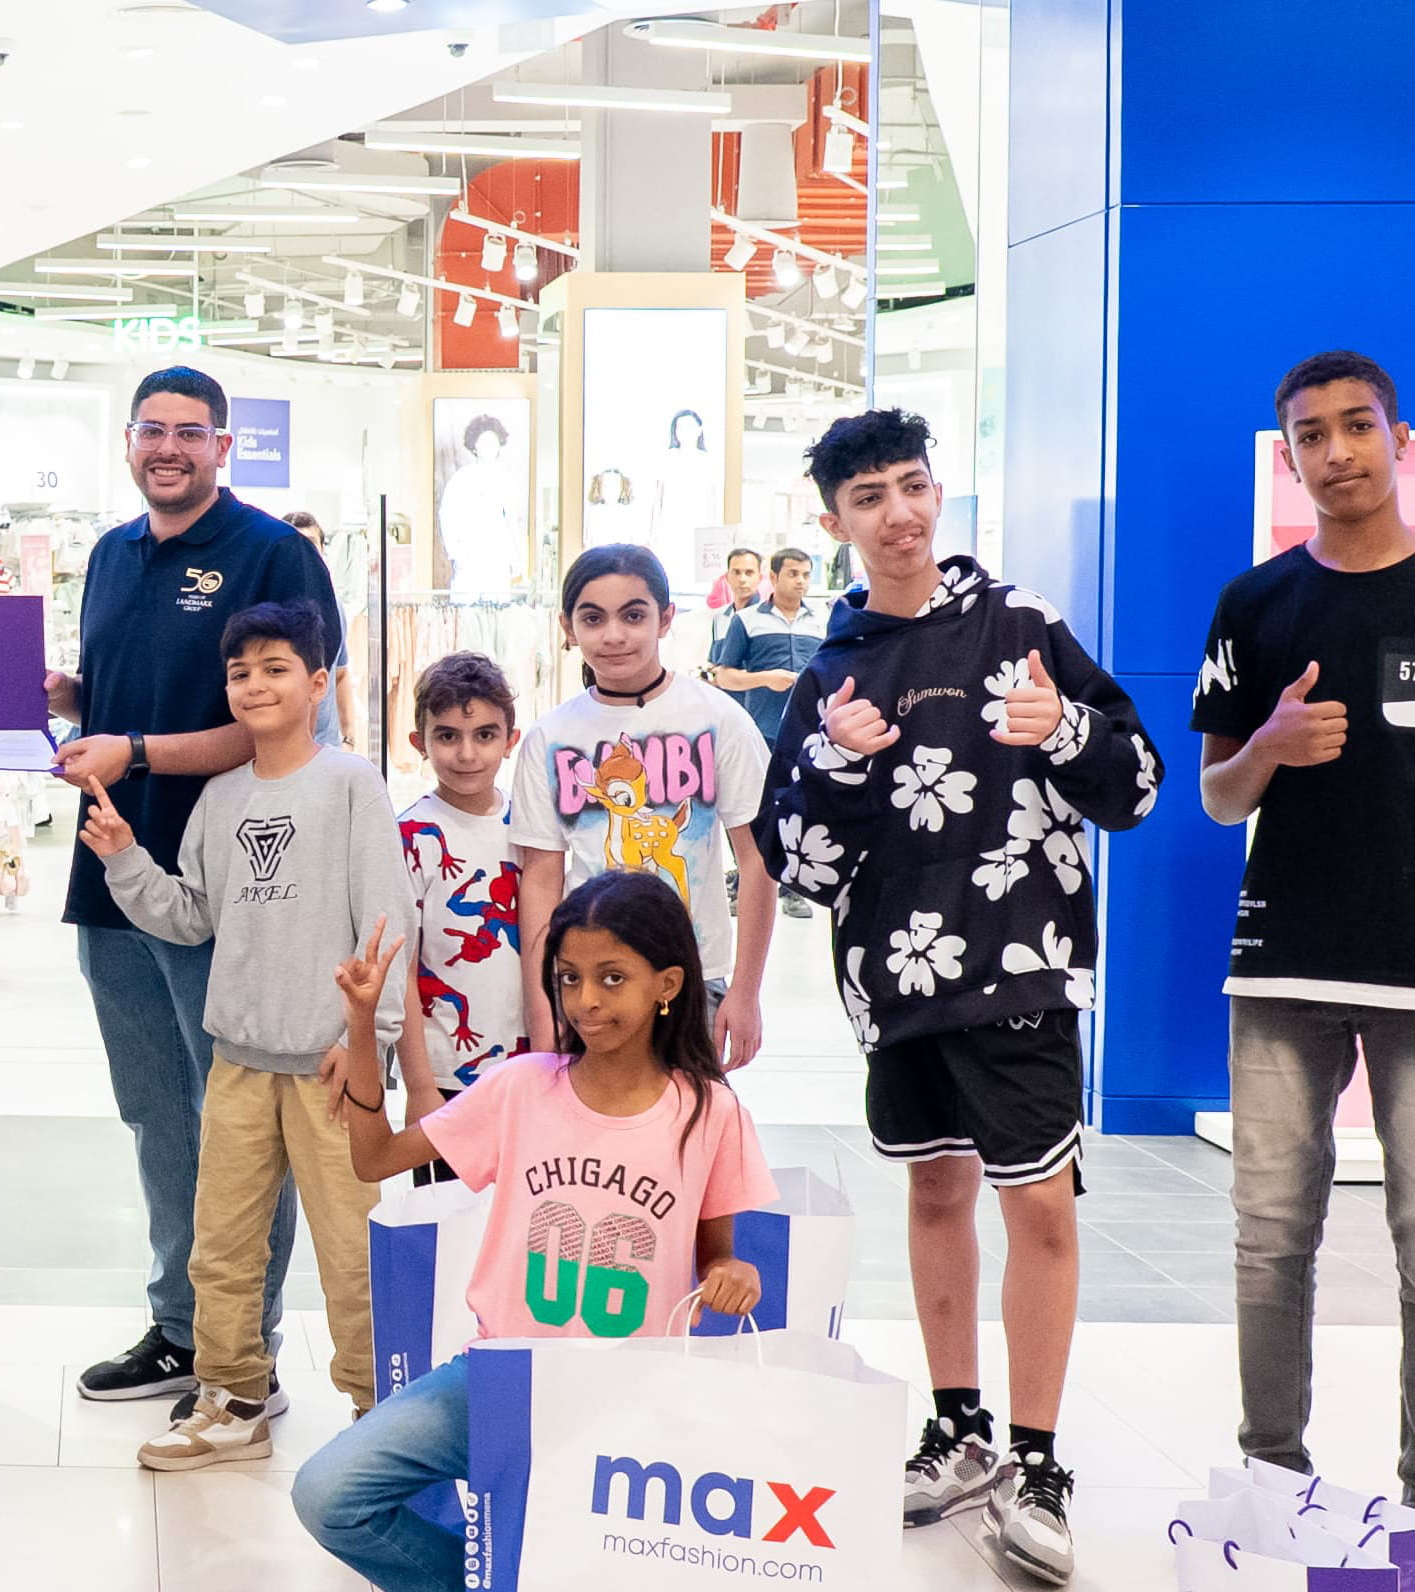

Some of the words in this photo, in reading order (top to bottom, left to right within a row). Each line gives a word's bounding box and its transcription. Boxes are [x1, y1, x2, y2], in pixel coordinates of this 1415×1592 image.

[114, 316, 202, 352] KIDS
[180, 567, 224, 594] 50
[233, 883, 298, 904] AKEL
[525, 1156, 676, 1221] CHIGAGO
[525, 1199, 657, 1338] 06
[591, 1454, 838, 1550] max
[603, 1534, 823, 1583] maxfashion.com
